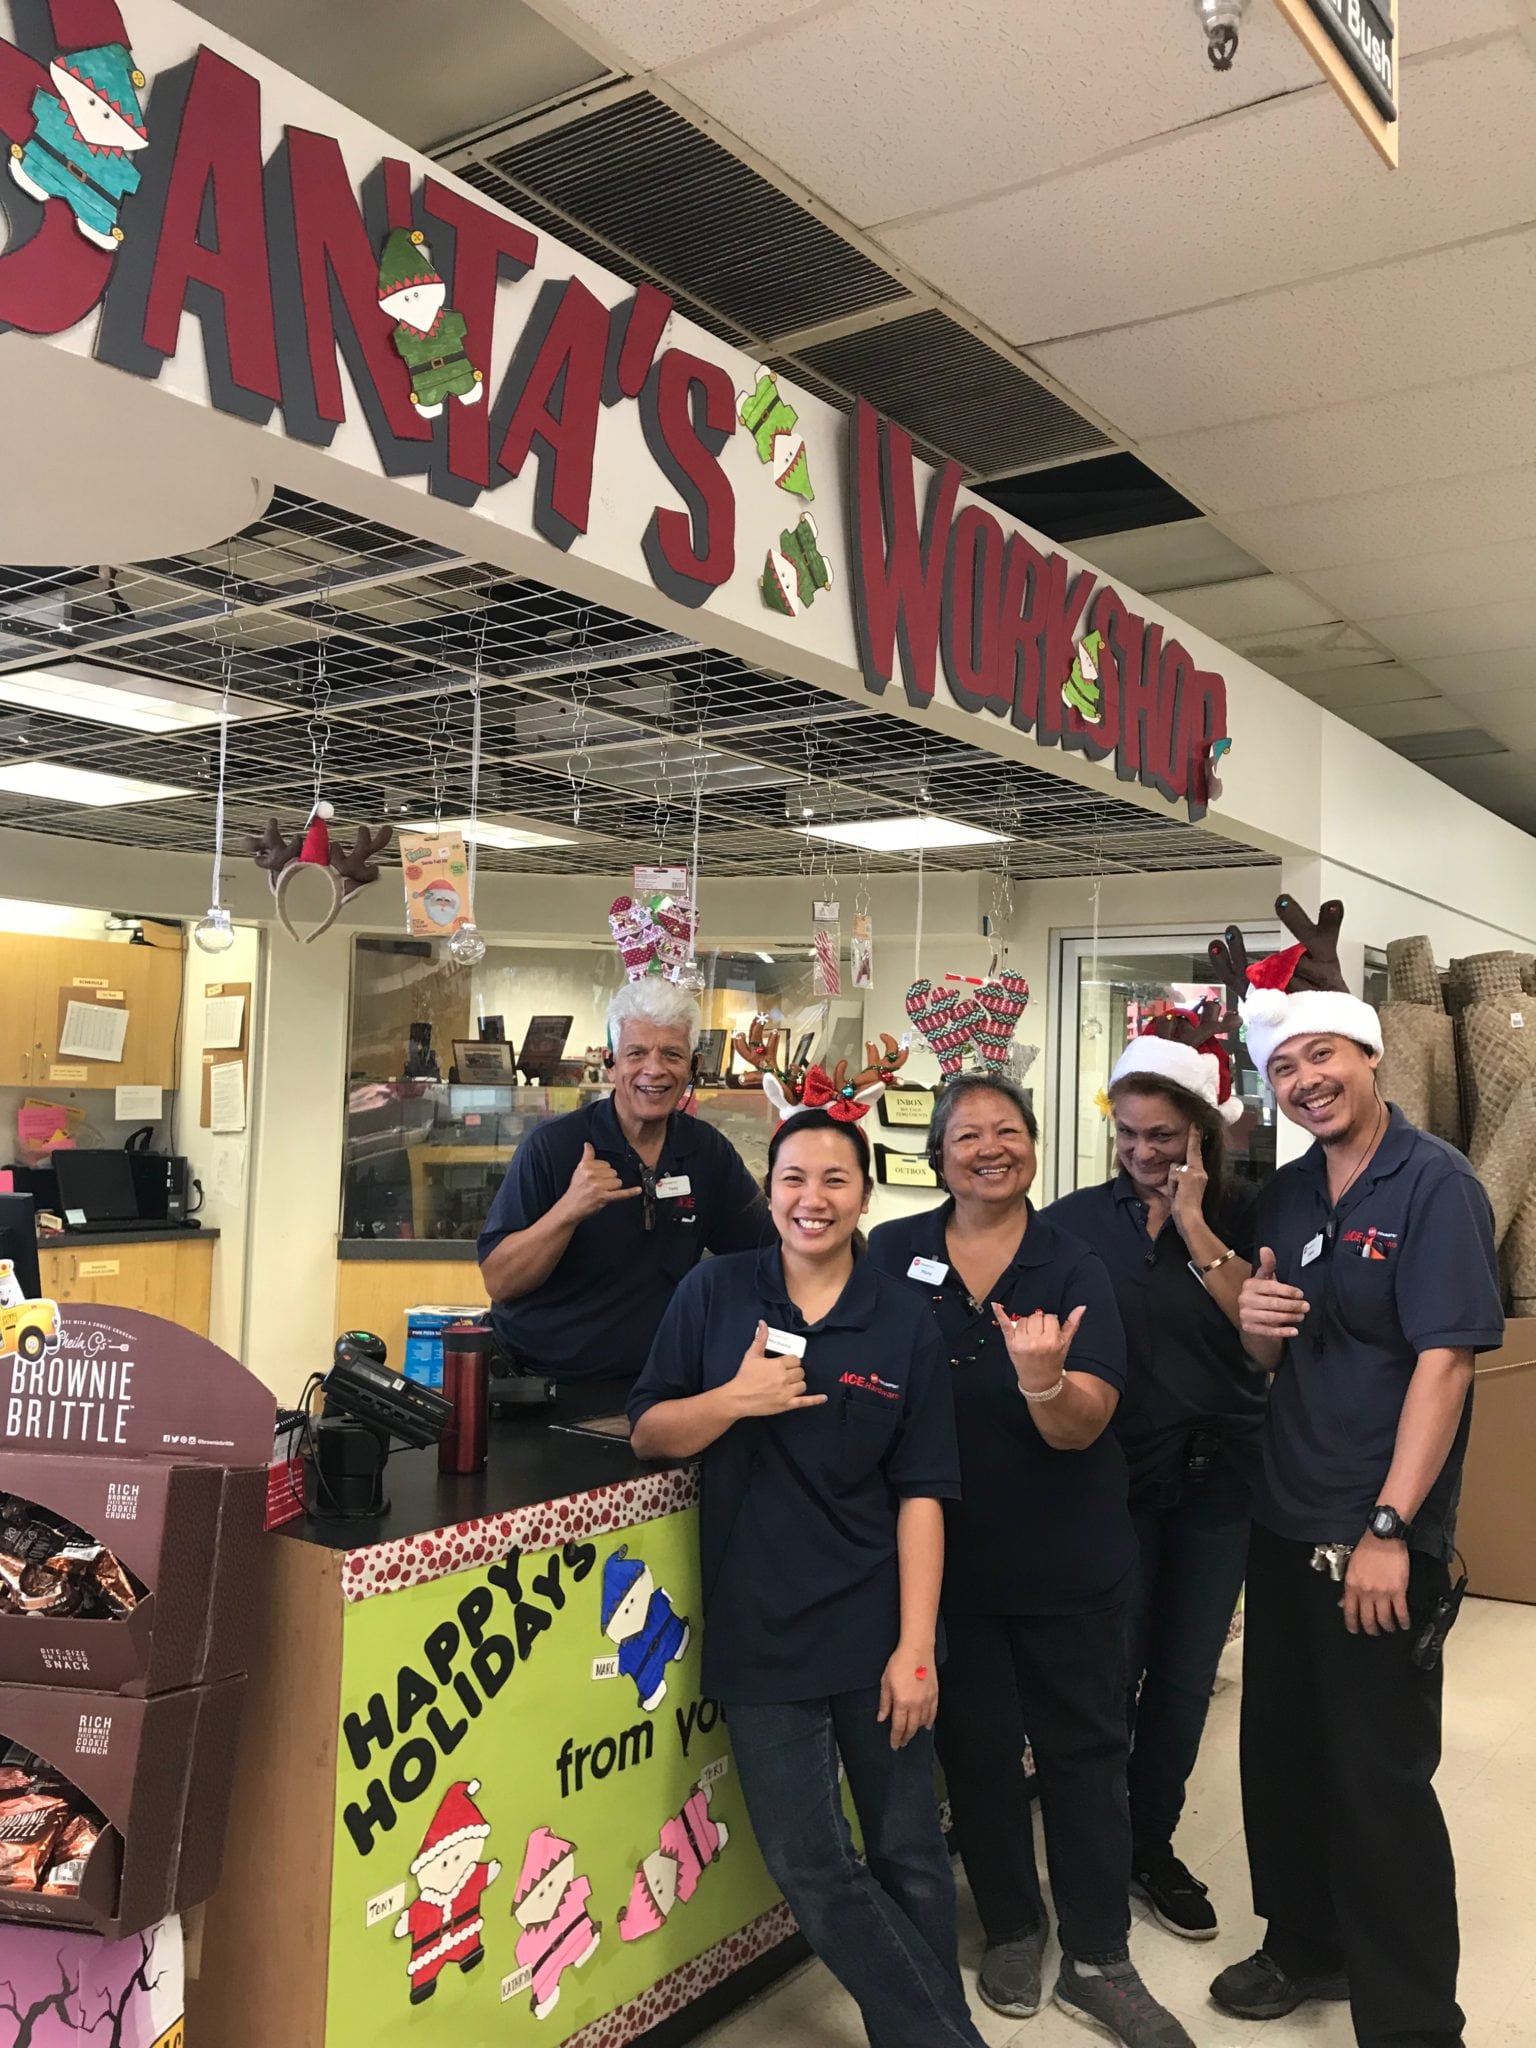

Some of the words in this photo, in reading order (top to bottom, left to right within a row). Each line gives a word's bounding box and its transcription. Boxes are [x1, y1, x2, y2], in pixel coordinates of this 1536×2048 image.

[1348, 0, 1392, 91] Bush
[852, 395, 1229, 810] WORKSHOP
[896, 1098, 923, 1107] INBOX
[895, 1166, 927, 1176] OUTBOX
[10, 1358, 135, 1401] BROWNIE
[838, 1370, 867, 1388] ACE
[5, 1398, 128, 1444] BRITTLE
[108, 1483, 140, 1496] RICH
[107, 1494, 138, 1502] BROWNIE
[106, 1504, 137, 1513] COOKIE
[105, 1511, 137, 1521] CRUNCH
[343, 1544, 523, 1770] HAPPY
[44, 1660, 91, 1671] SNACK
[343, 1541, 596, 1857] HOLIDAYS
[79, 1714, 112, 1728] RICH
[78, 1726, 111, 1736] BROWNIE
[76, 1738, 109, 1748] COOKIE
[75, 1745, 108, 1756] CRUNCH
[556, 1719, 654, 1799] from
